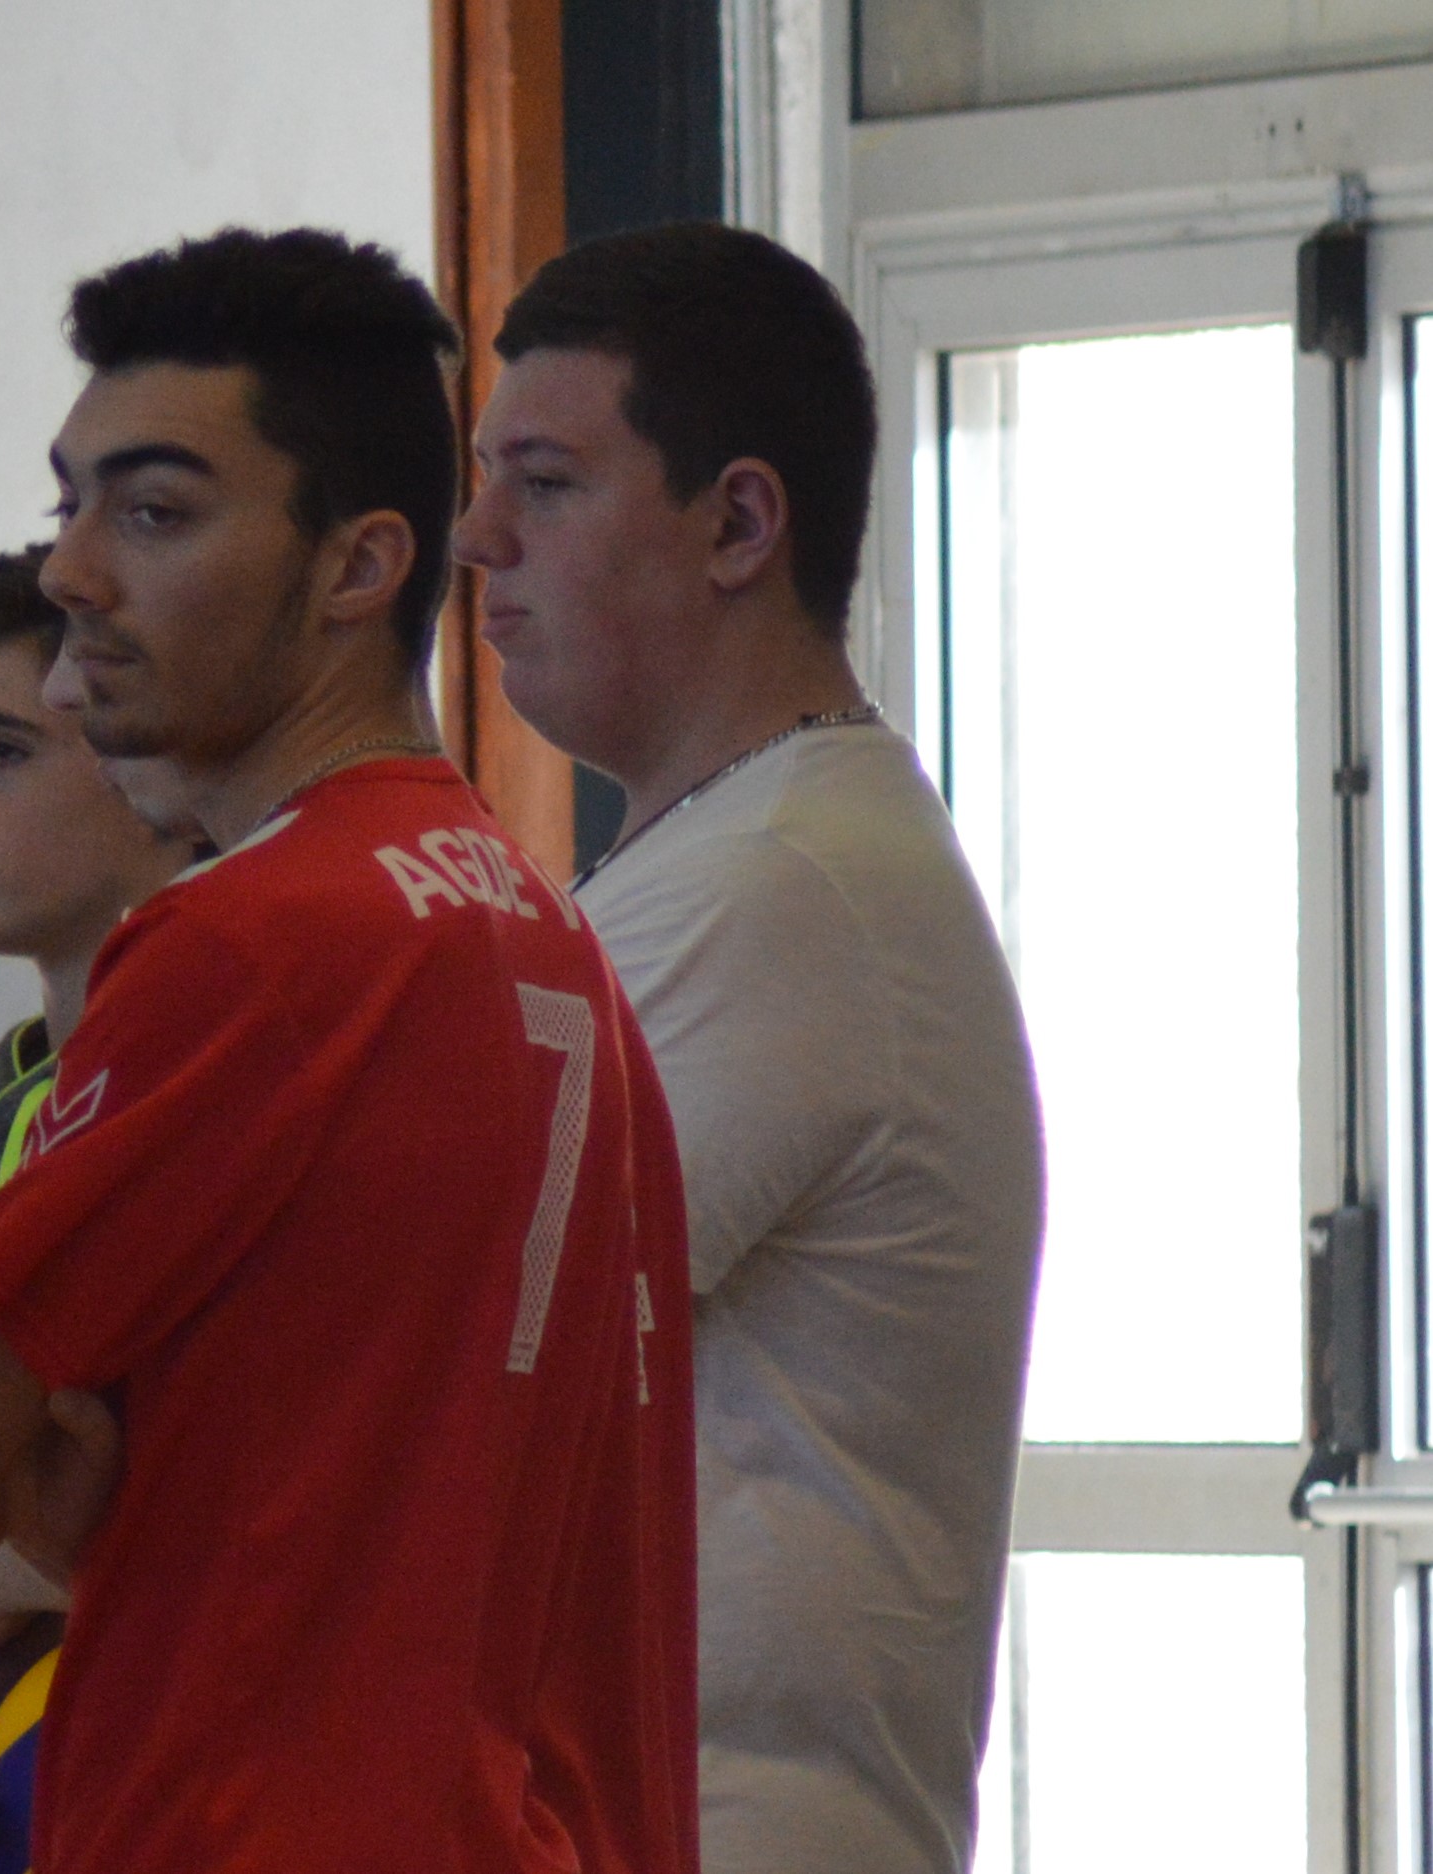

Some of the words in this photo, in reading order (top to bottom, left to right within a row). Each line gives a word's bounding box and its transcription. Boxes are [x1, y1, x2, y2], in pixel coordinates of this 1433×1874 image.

[373, 827, 539, 920] AGDE
[518, 849, 581, 931] V
[505, 981, 595, 1374] 7
